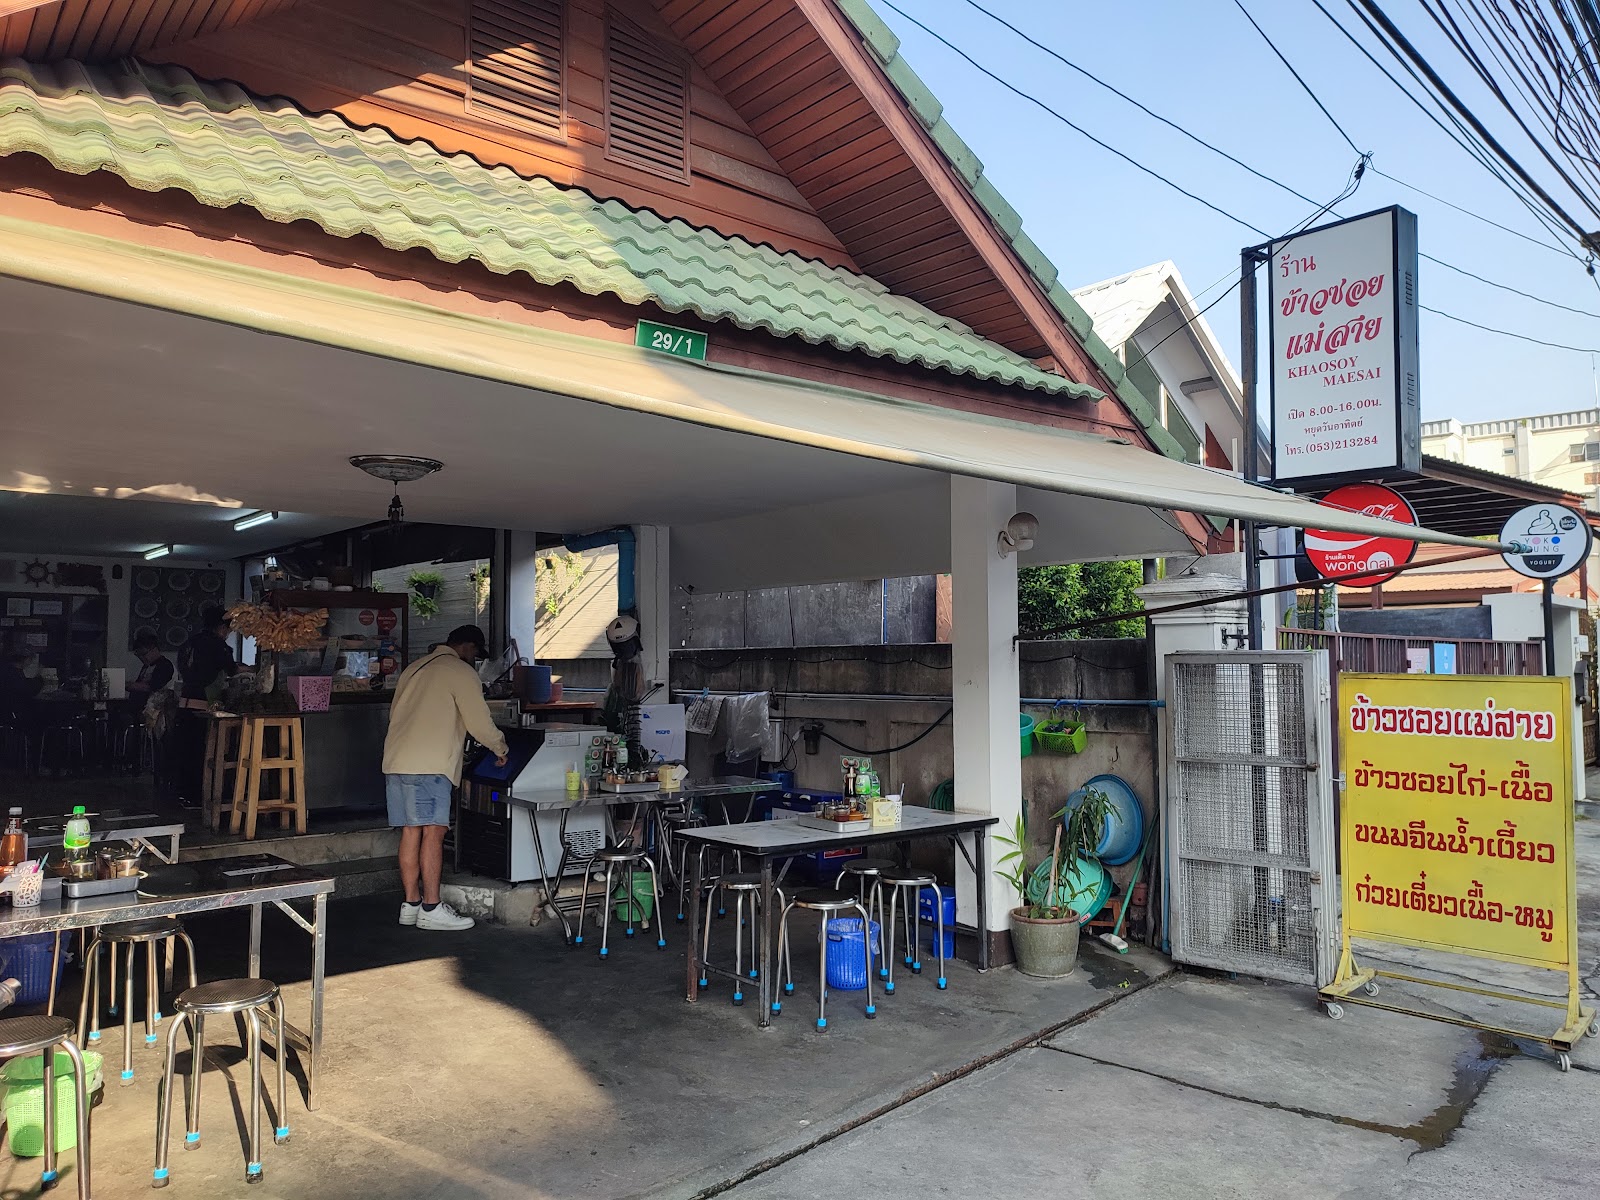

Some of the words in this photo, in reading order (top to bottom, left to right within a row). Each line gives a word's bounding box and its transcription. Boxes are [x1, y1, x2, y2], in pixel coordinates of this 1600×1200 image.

[1280, 253, 1317, 278] ร้าน
[1281, 274, 1385, 317] ข้าวซอย
[652, 330, 692, 354] 29/1
[1286, 314, 1383, 360] แม่สาย
[1287, 355, 1359, 379] KHAOSOY
[1323, 366, 1381, 388] MAESAI
[1288, 407, 1305, 421] เปิด
[1304, 416, 1364, 437] หยุดวันอาทิตย์
[1325, 556, 1390, 573] wongnai
[1351, 694, 1555, 740] ข้าวซอยแม่สาย
[1354, 760, 1553, 802] ข้าวซอยไก่-เนื้อ
[1355, 817, 1555, 864] ขนมจีนน้ำเงี้ยว
[1355, 871, 1554, 942] ก๋วยเตี๋ยวเนื้อ-หมู
